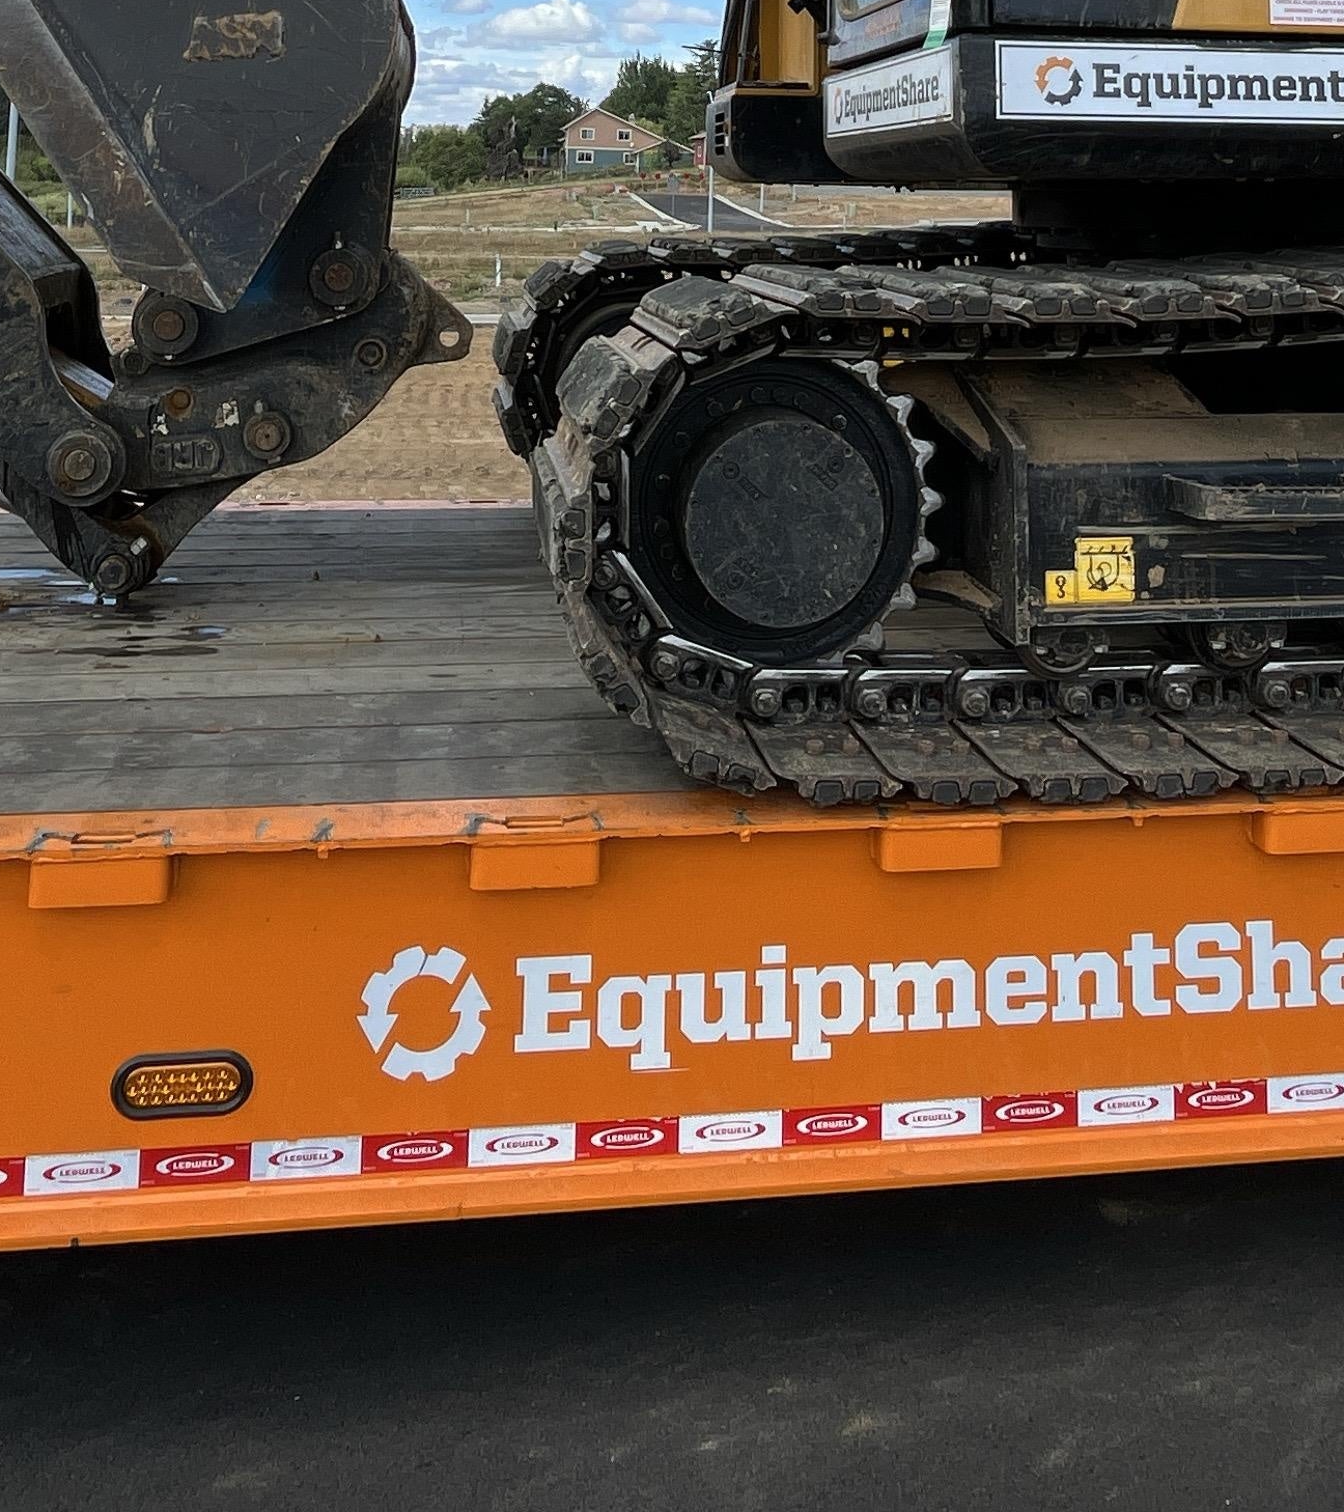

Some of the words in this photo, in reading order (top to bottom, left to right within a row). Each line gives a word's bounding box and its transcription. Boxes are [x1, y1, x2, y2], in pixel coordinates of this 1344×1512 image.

[843, 73, 940, 124] EquipmentShare
[1200, 1091, 1241, 1104] LEDWELL
[1295, 1085, 1335, 1097] LEDWELL
[1008, 1103, 1051, 1116] LEDWELL
[1106, 1097, 1147, 1110] LEDWELL
[811, 1116, 854, 1130] LEDWELL
[911, 1110, 953, 1123] LEDWELL
[709, 1124, 752, 1136] LEDWELL
[500, 1136, 545, 1150] LEDWELL
[605, 1130, 650, 1144] LEDWELL
[283, 1150, 330, 1163] LEDWELL
[392, 1143, 438, 1157] LEDWELL
[171, 1157, 219, 1170] LEDWELL
[59, 1165, 107, 1178] LEDWELL
